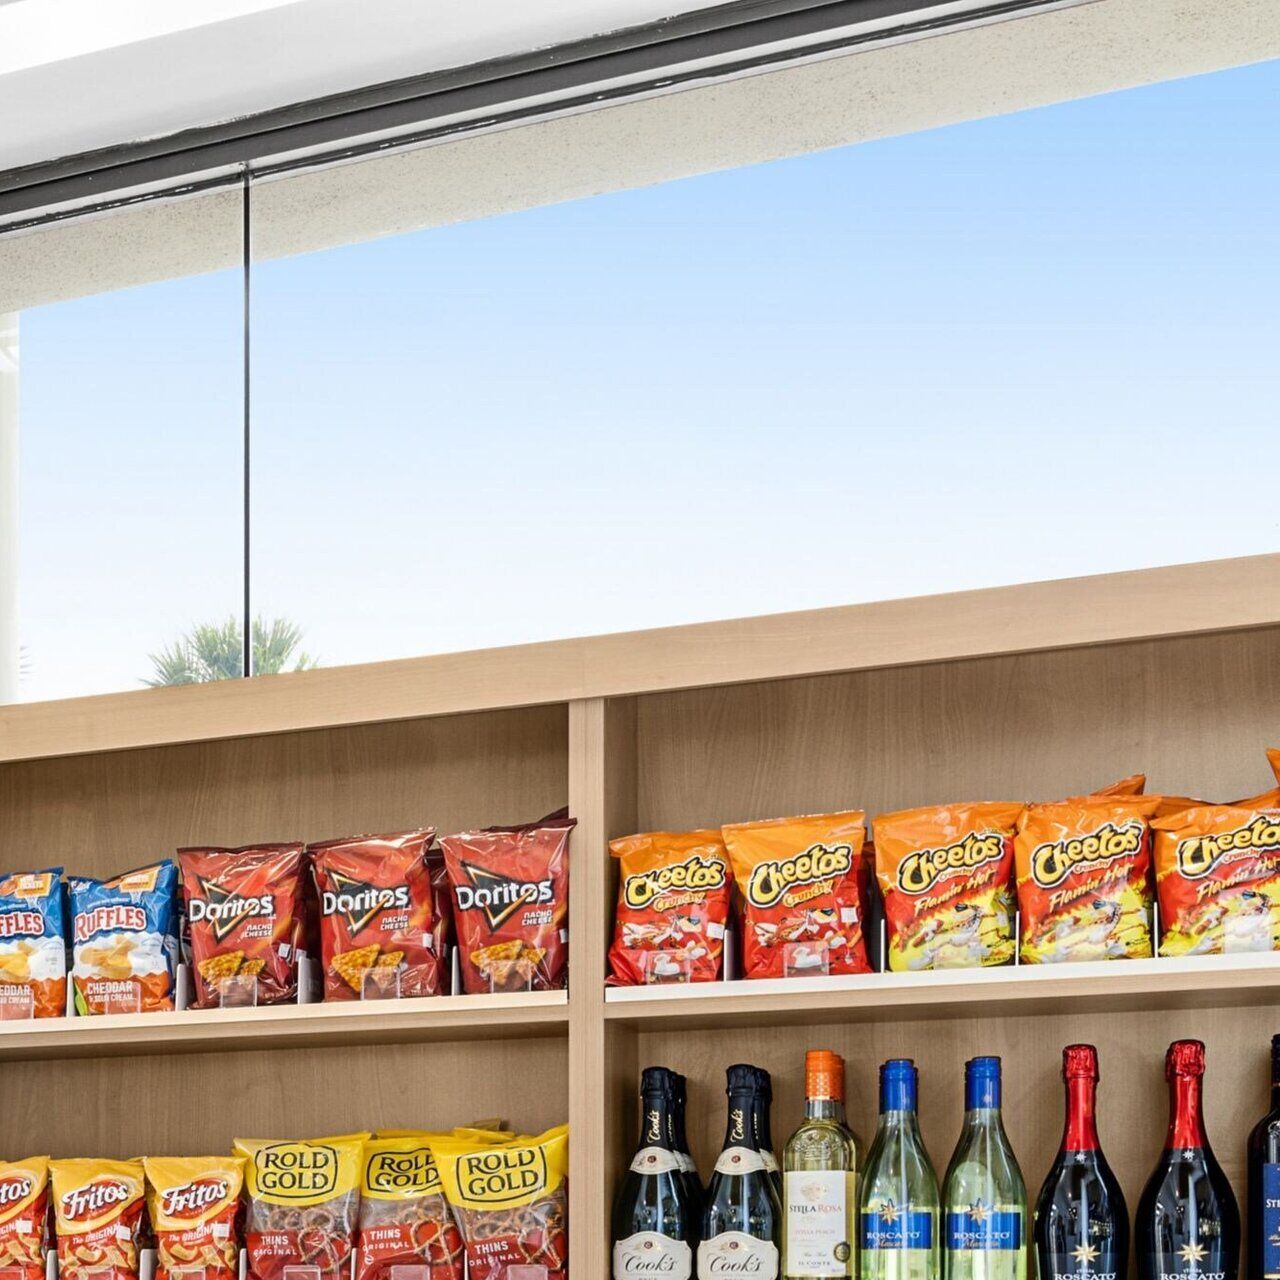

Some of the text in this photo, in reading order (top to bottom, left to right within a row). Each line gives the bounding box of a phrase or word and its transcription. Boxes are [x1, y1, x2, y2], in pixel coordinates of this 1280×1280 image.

[1033, 822, 1142, 886] Cheetos
[1180, 816, 1280, 877] Cheeto
[900, 833, 1003, 893] Cheetos
[627, 858, 725, 908] Cheetos
[751, 845, 852, 907] Cheetos
[966, 867, 997, 888] Hot
[1102, 863, 1135, 885] Hot
[323, 886, 408, 915] Doritos
[455, 880, 553, 910] Doritos
[653, 891, 706, 912] Crunchy
[782, 880, 834, 907] Crunchy
[190, 894, 274, 922] Doritos
[523, 910, 553, 918] NACHO
[74, 905, 147, 940] RUFFLES
[246, 923, 273, 931] NACHO
[380, 922, 409, 930] CHEESE
[381, 916, 408, 924] NACHO
[521, 917, 554, 926] CHEESE
[243, 930, 273, 938] CHEESE
[86, 982, 134, 994] CHEDDAR
[647, 1108, 661, 1143] Cook's
[730, 1106, 746, 1144] Cook's
[264, 1150, 330, 1170] ROLD
[379, 1151, 436, 1173] ROLD
[468, 1149, 535, 1175] ROLD
[262, 1170, 329, 1190] GOLD
[375, 1167, 441, 1187] GOLD
[468, 1168, 539, 1196] GOLD
[62, 1181, 129, 1220] Fritos
[162, 1180, 228, 1217] Fritos
[789, 1204, 817, 1214] STELLA
[260, 1235, 289, 1246] THINS
[370, 1229, 401, 1240] THINS
[867, 1231, 921, 1240] ROSCATO
[954, 1231, 1010, 1240] ROSCATO
[253, 1247, 298, 1257] ORIGINAL
[362, 1241, 410, 1251] ORIGINAL
[474, 1240, 509, 1254] THINS
[469, 1253, 522, 1267] ORIGINAL
[624, 1250, 679, 1272] Cook's
[710, 1250, 764, 1273] Cook's
[1055, 1272, 1116, 1280] ROSCATO
[1161, 1272, 1225, 1280] ROSCATO
